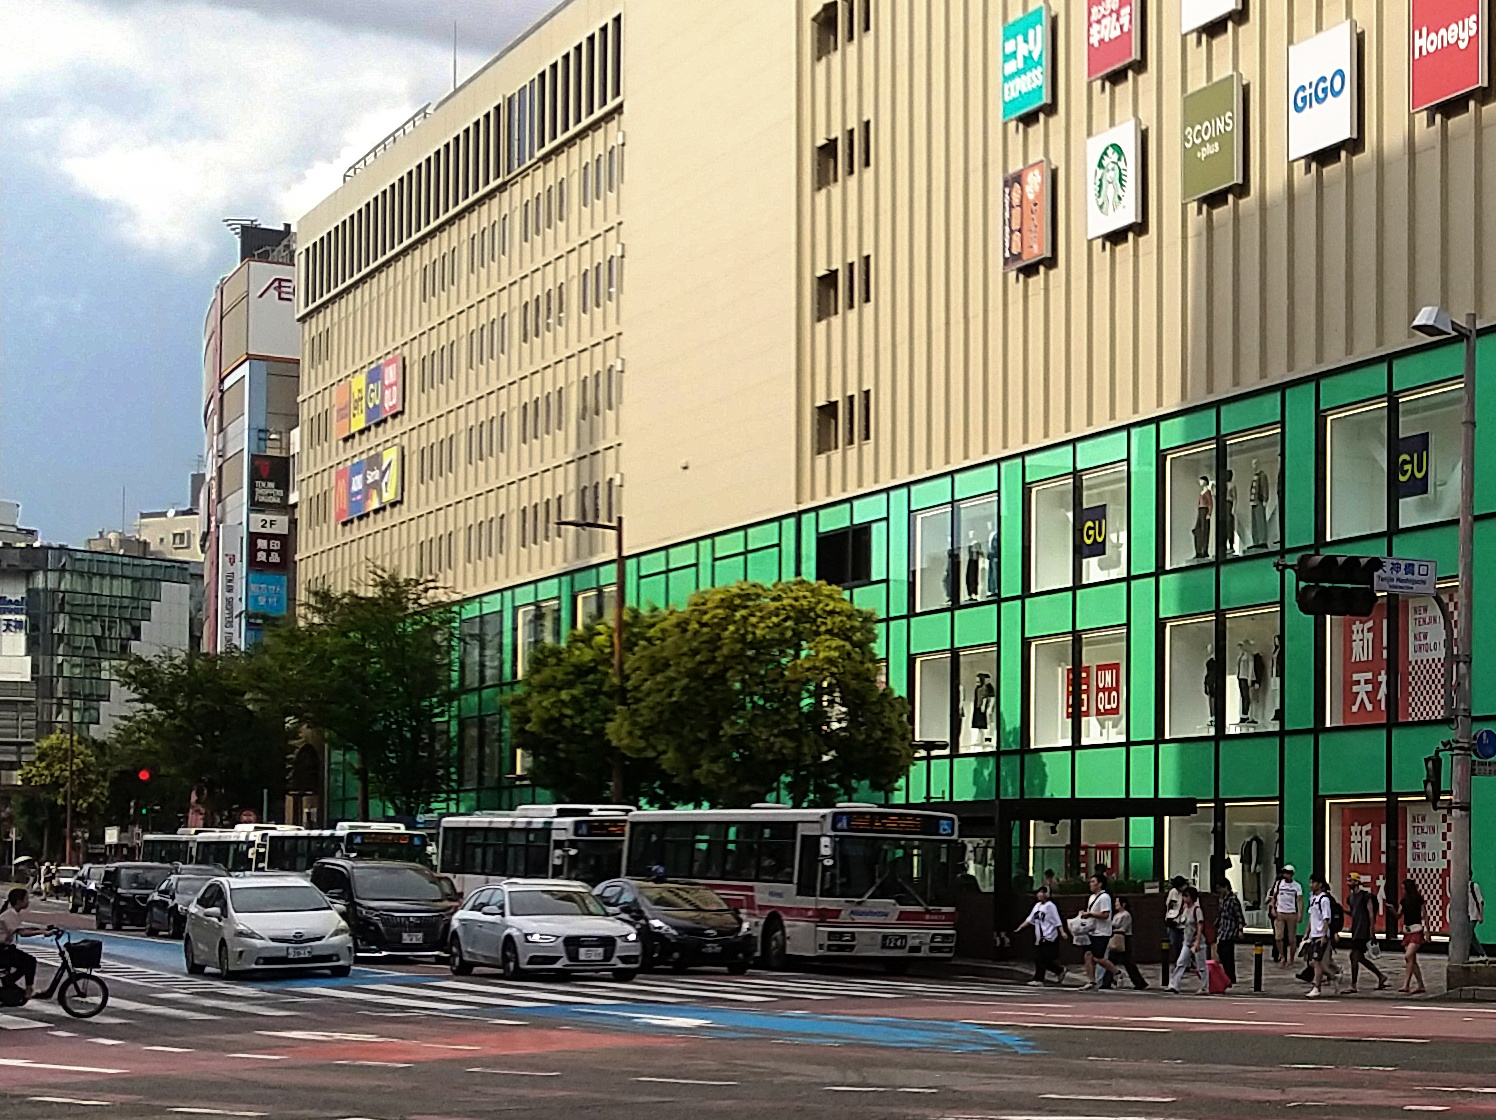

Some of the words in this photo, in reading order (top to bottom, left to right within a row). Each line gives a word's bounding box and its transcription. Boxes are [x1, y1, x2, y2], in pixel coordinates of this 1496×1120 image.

[1090, 5, 1130, 47] キタムラ
[1414, 14, 1478, 59] Honeys
[1004, 24, 1042, 76] ニトリ
[1293, 68, 1346, 115] GiGO
[1184, 111, 1233, 148] 3COINS
[367, 381, 381, 408] GU
[1399, 450, 1427, 482] GU
[260, 519, 277, 528] 2F
[1083, 519, 1106, 545] GU
[1413, 606, 1429, 615] NEW
[1413, 632, 1429, 641] NEW
[1097, 669, 1117, 688] UNI
[1097, 691, 1117, 712] QLO
[1412, 814, 1426, 823] NEW
[1412, 840, 1426, 850] NEW
